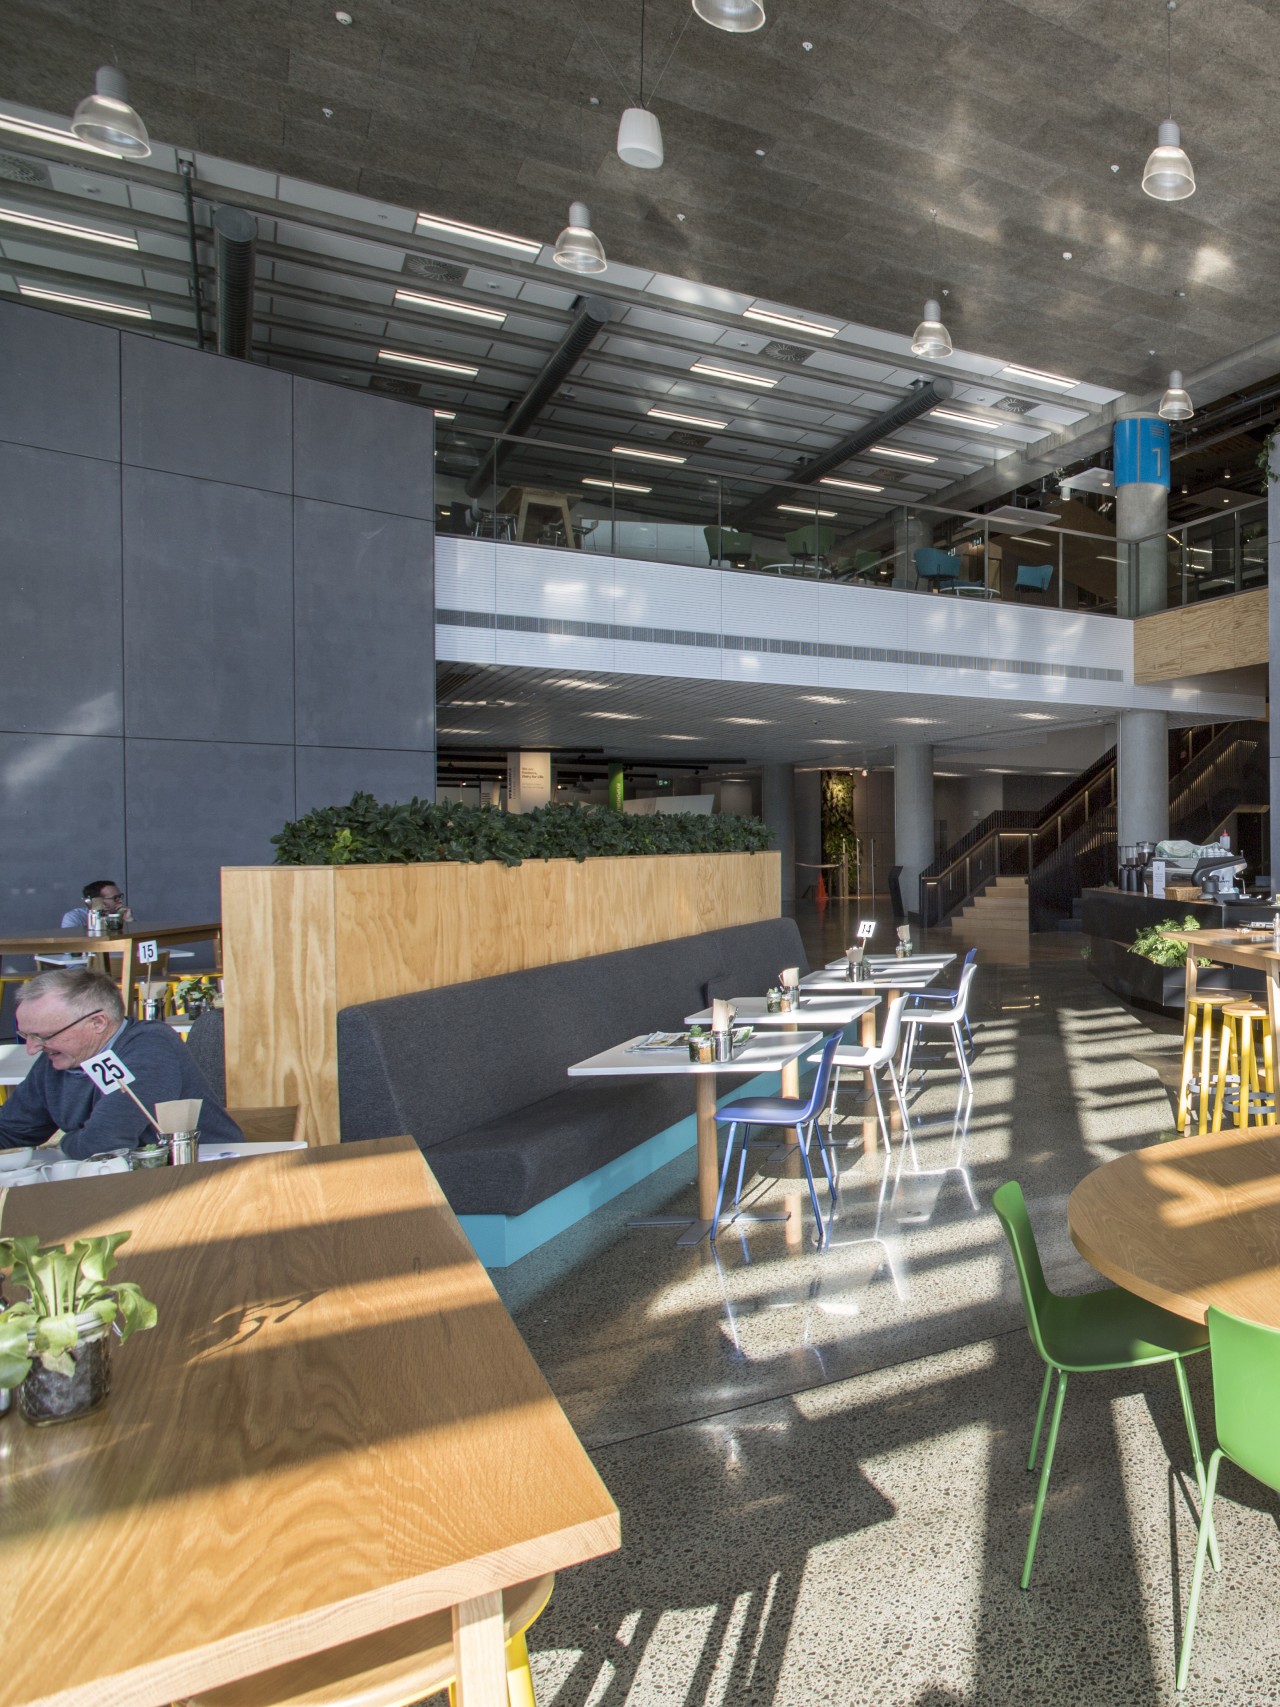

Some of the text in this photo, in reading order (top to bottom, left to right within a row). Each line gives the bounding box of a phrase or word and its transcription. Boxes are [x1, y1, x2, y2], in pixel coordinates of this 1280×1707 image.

[862, 924, 872, 934] 14
[142, 944, 154, 959] 15
[92, 1057, 125, 1086] 25
